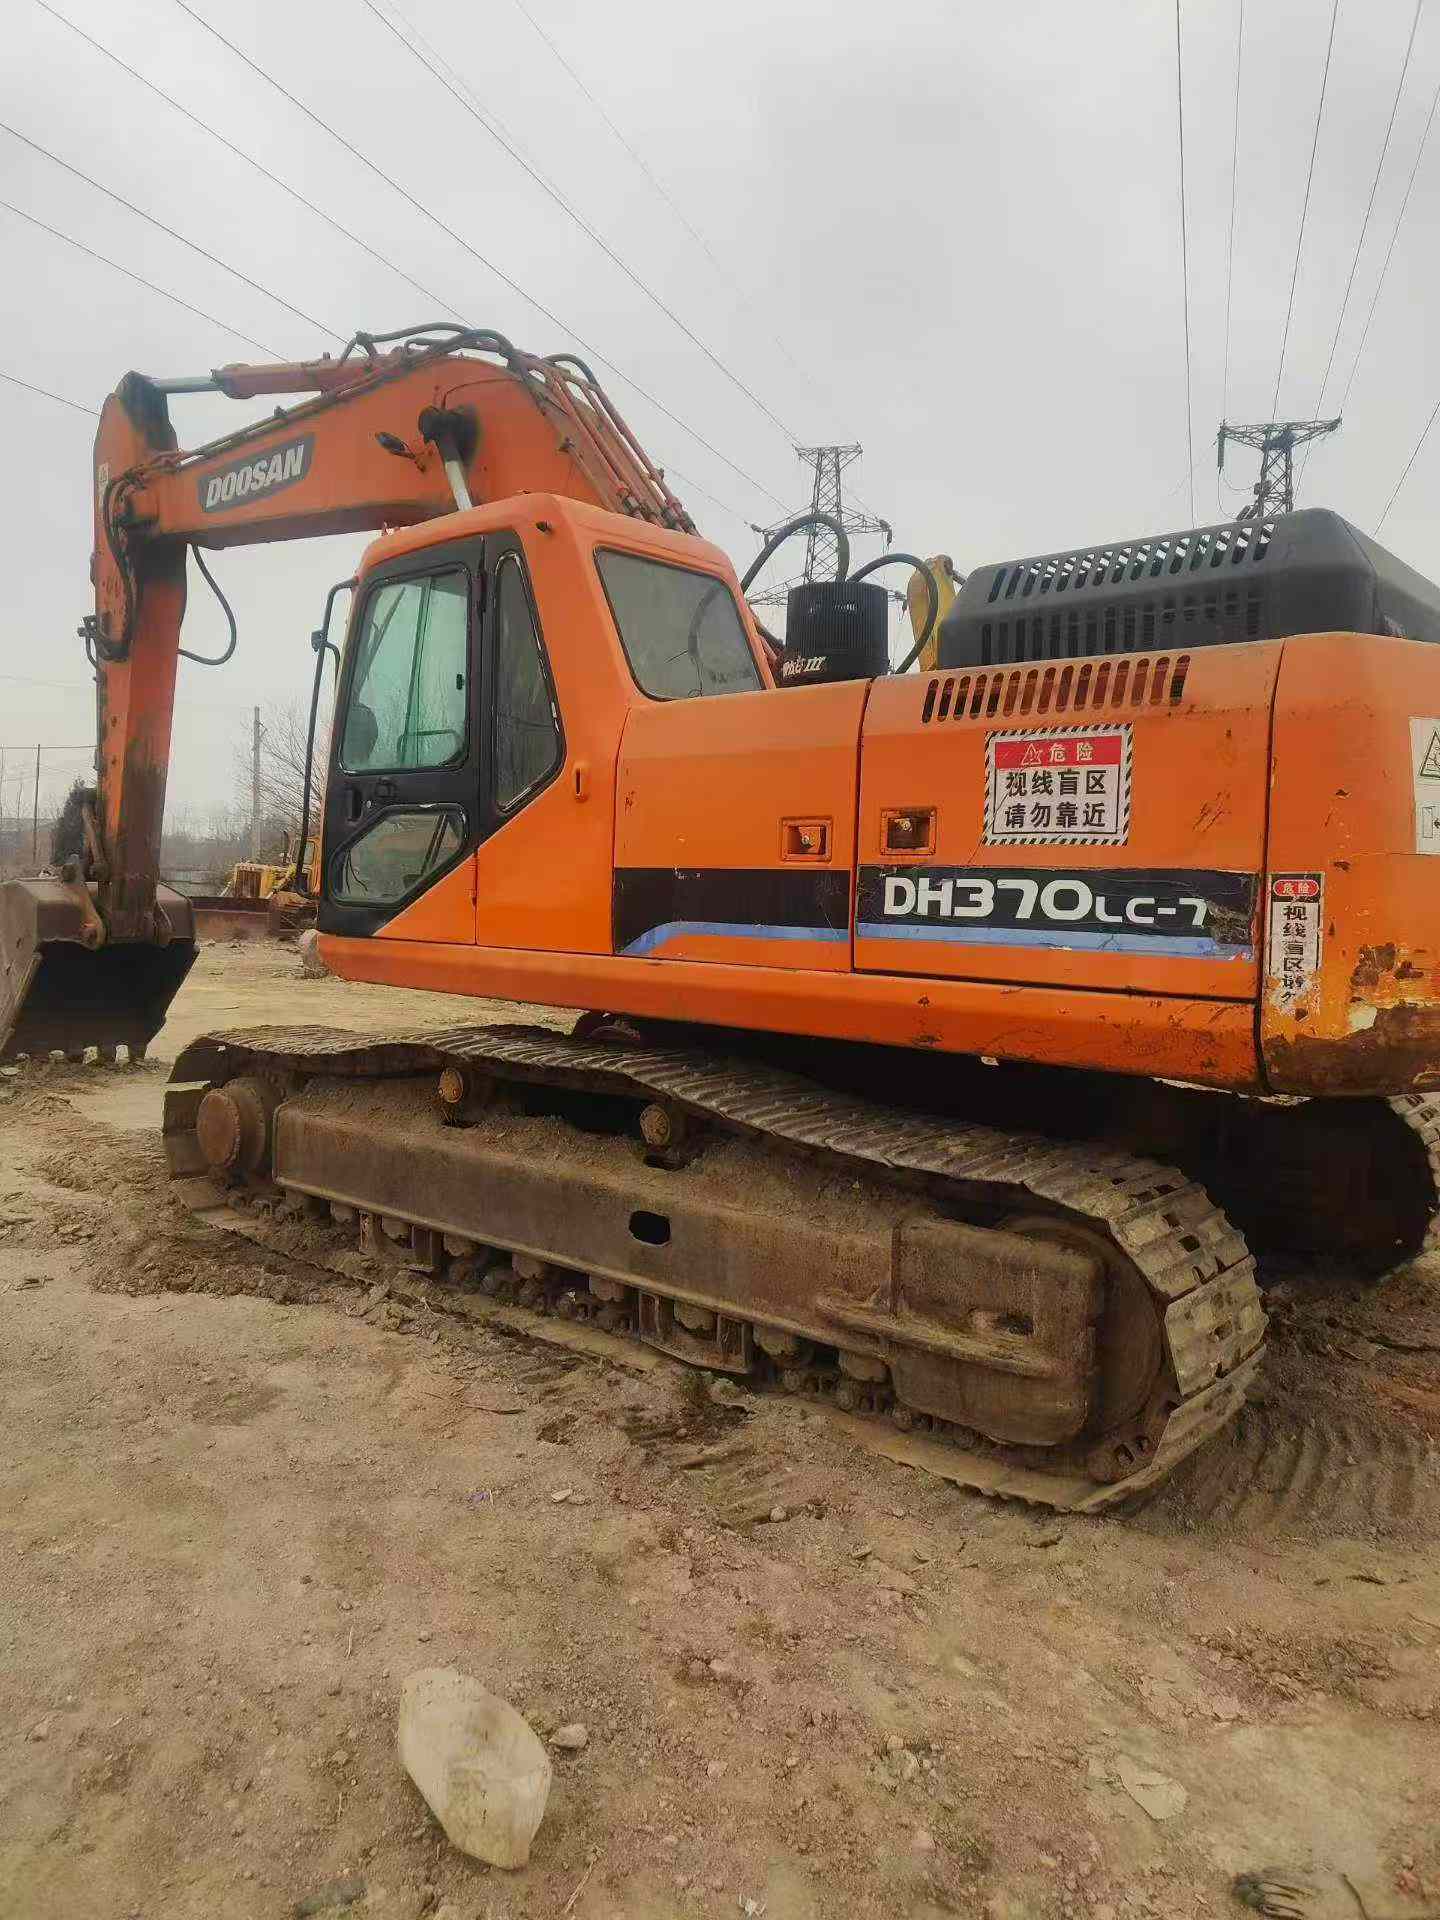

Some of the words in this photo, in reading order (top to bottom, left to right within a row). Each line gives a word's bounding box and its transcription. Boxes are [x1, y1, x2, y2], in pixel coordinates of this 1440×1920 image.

[205, 443, 304, 509] DOOSAN
[1049, 742, 1094, 762] 危险
[1005, 768, 1108, 797] 视线盲区
[1004, 801, 1106, 829] 请勿靠近
[1282, 882, 1311, 895] 危险
